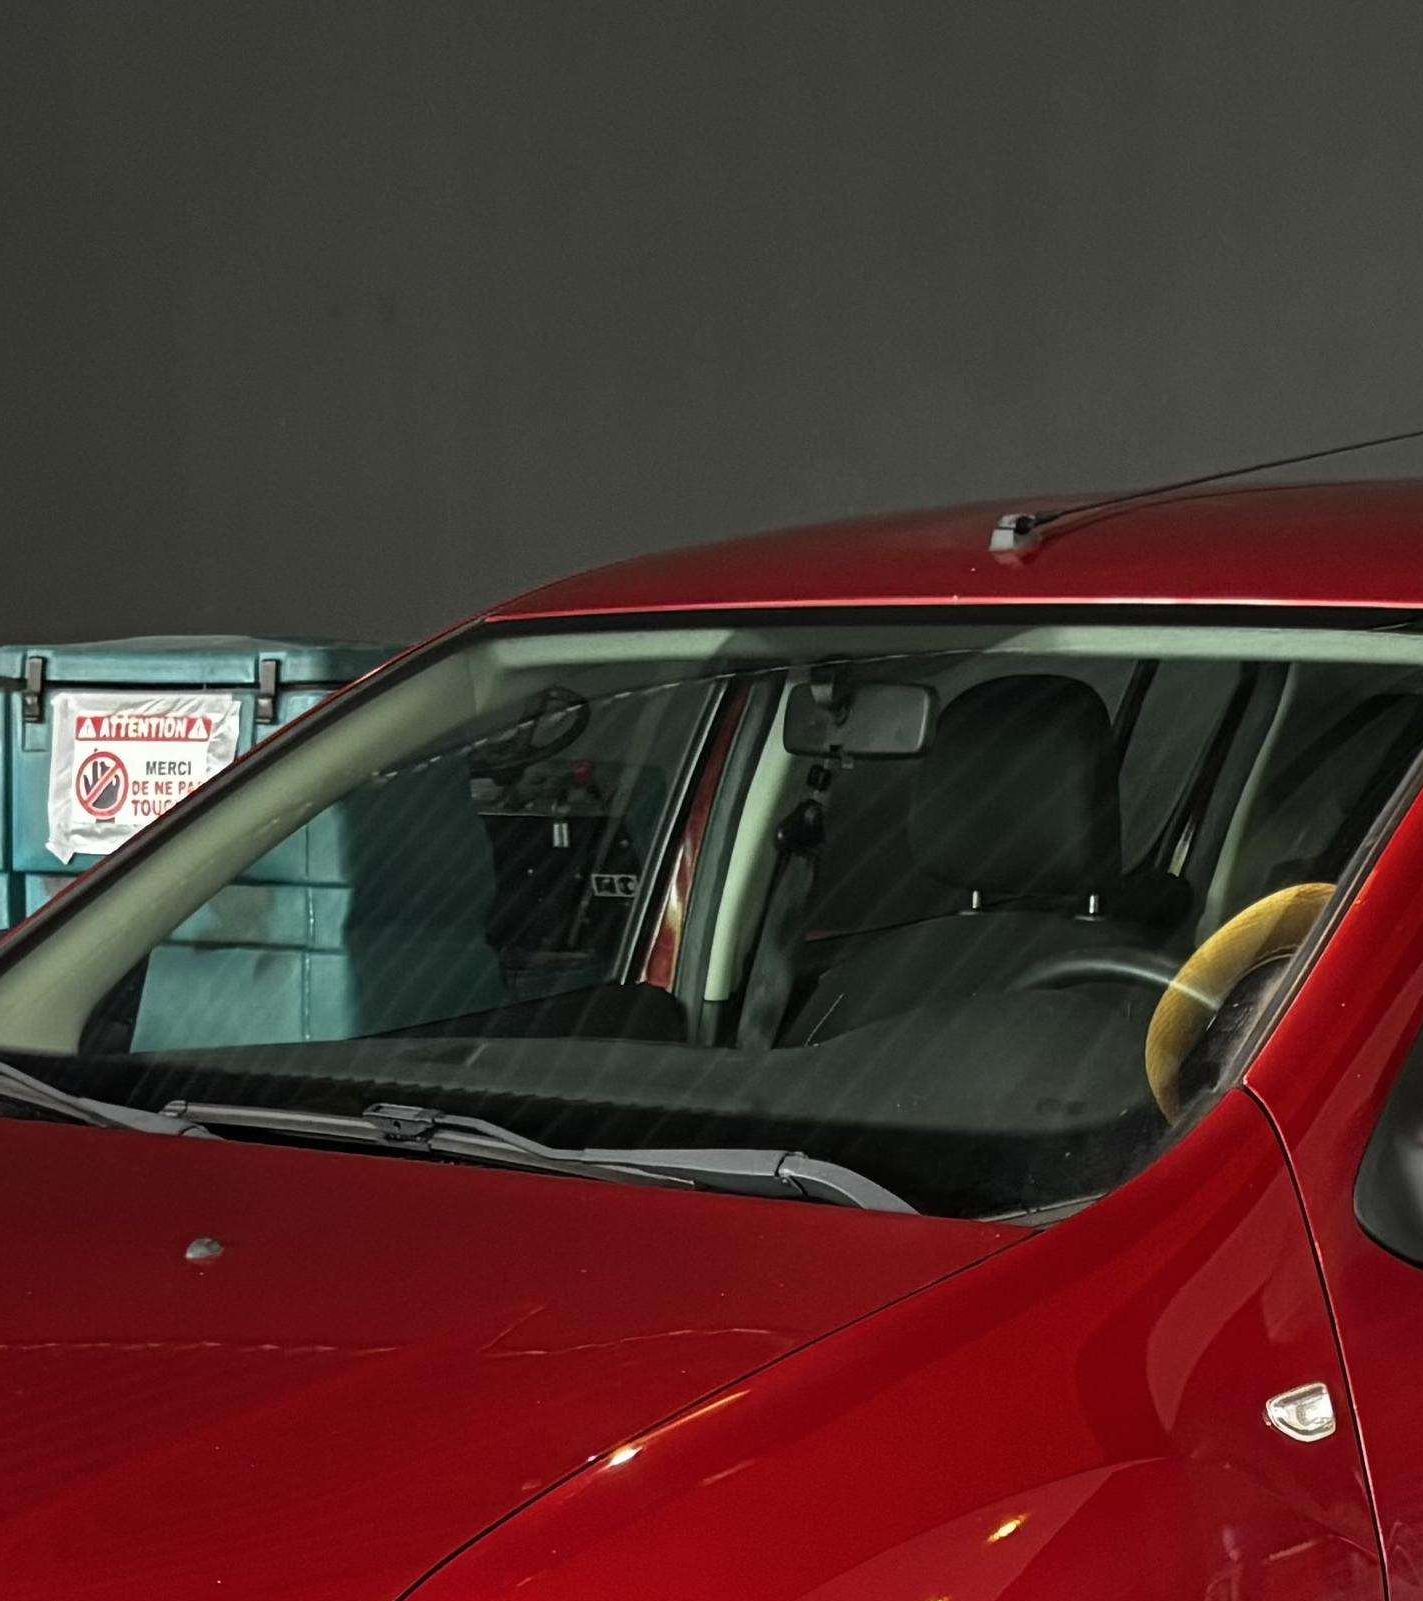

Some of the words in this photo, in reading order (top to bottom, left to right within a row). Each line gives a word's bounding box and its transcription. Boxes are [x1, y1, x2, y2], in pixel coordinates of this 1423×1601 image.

[98, 716, 187, 739] ATTENTION
[145, 760, 192, 776] MERCI
[131, 780, 149, 795] DE
[154, 780, 174, 795] NE
[178, 780, 203, 795] PA
